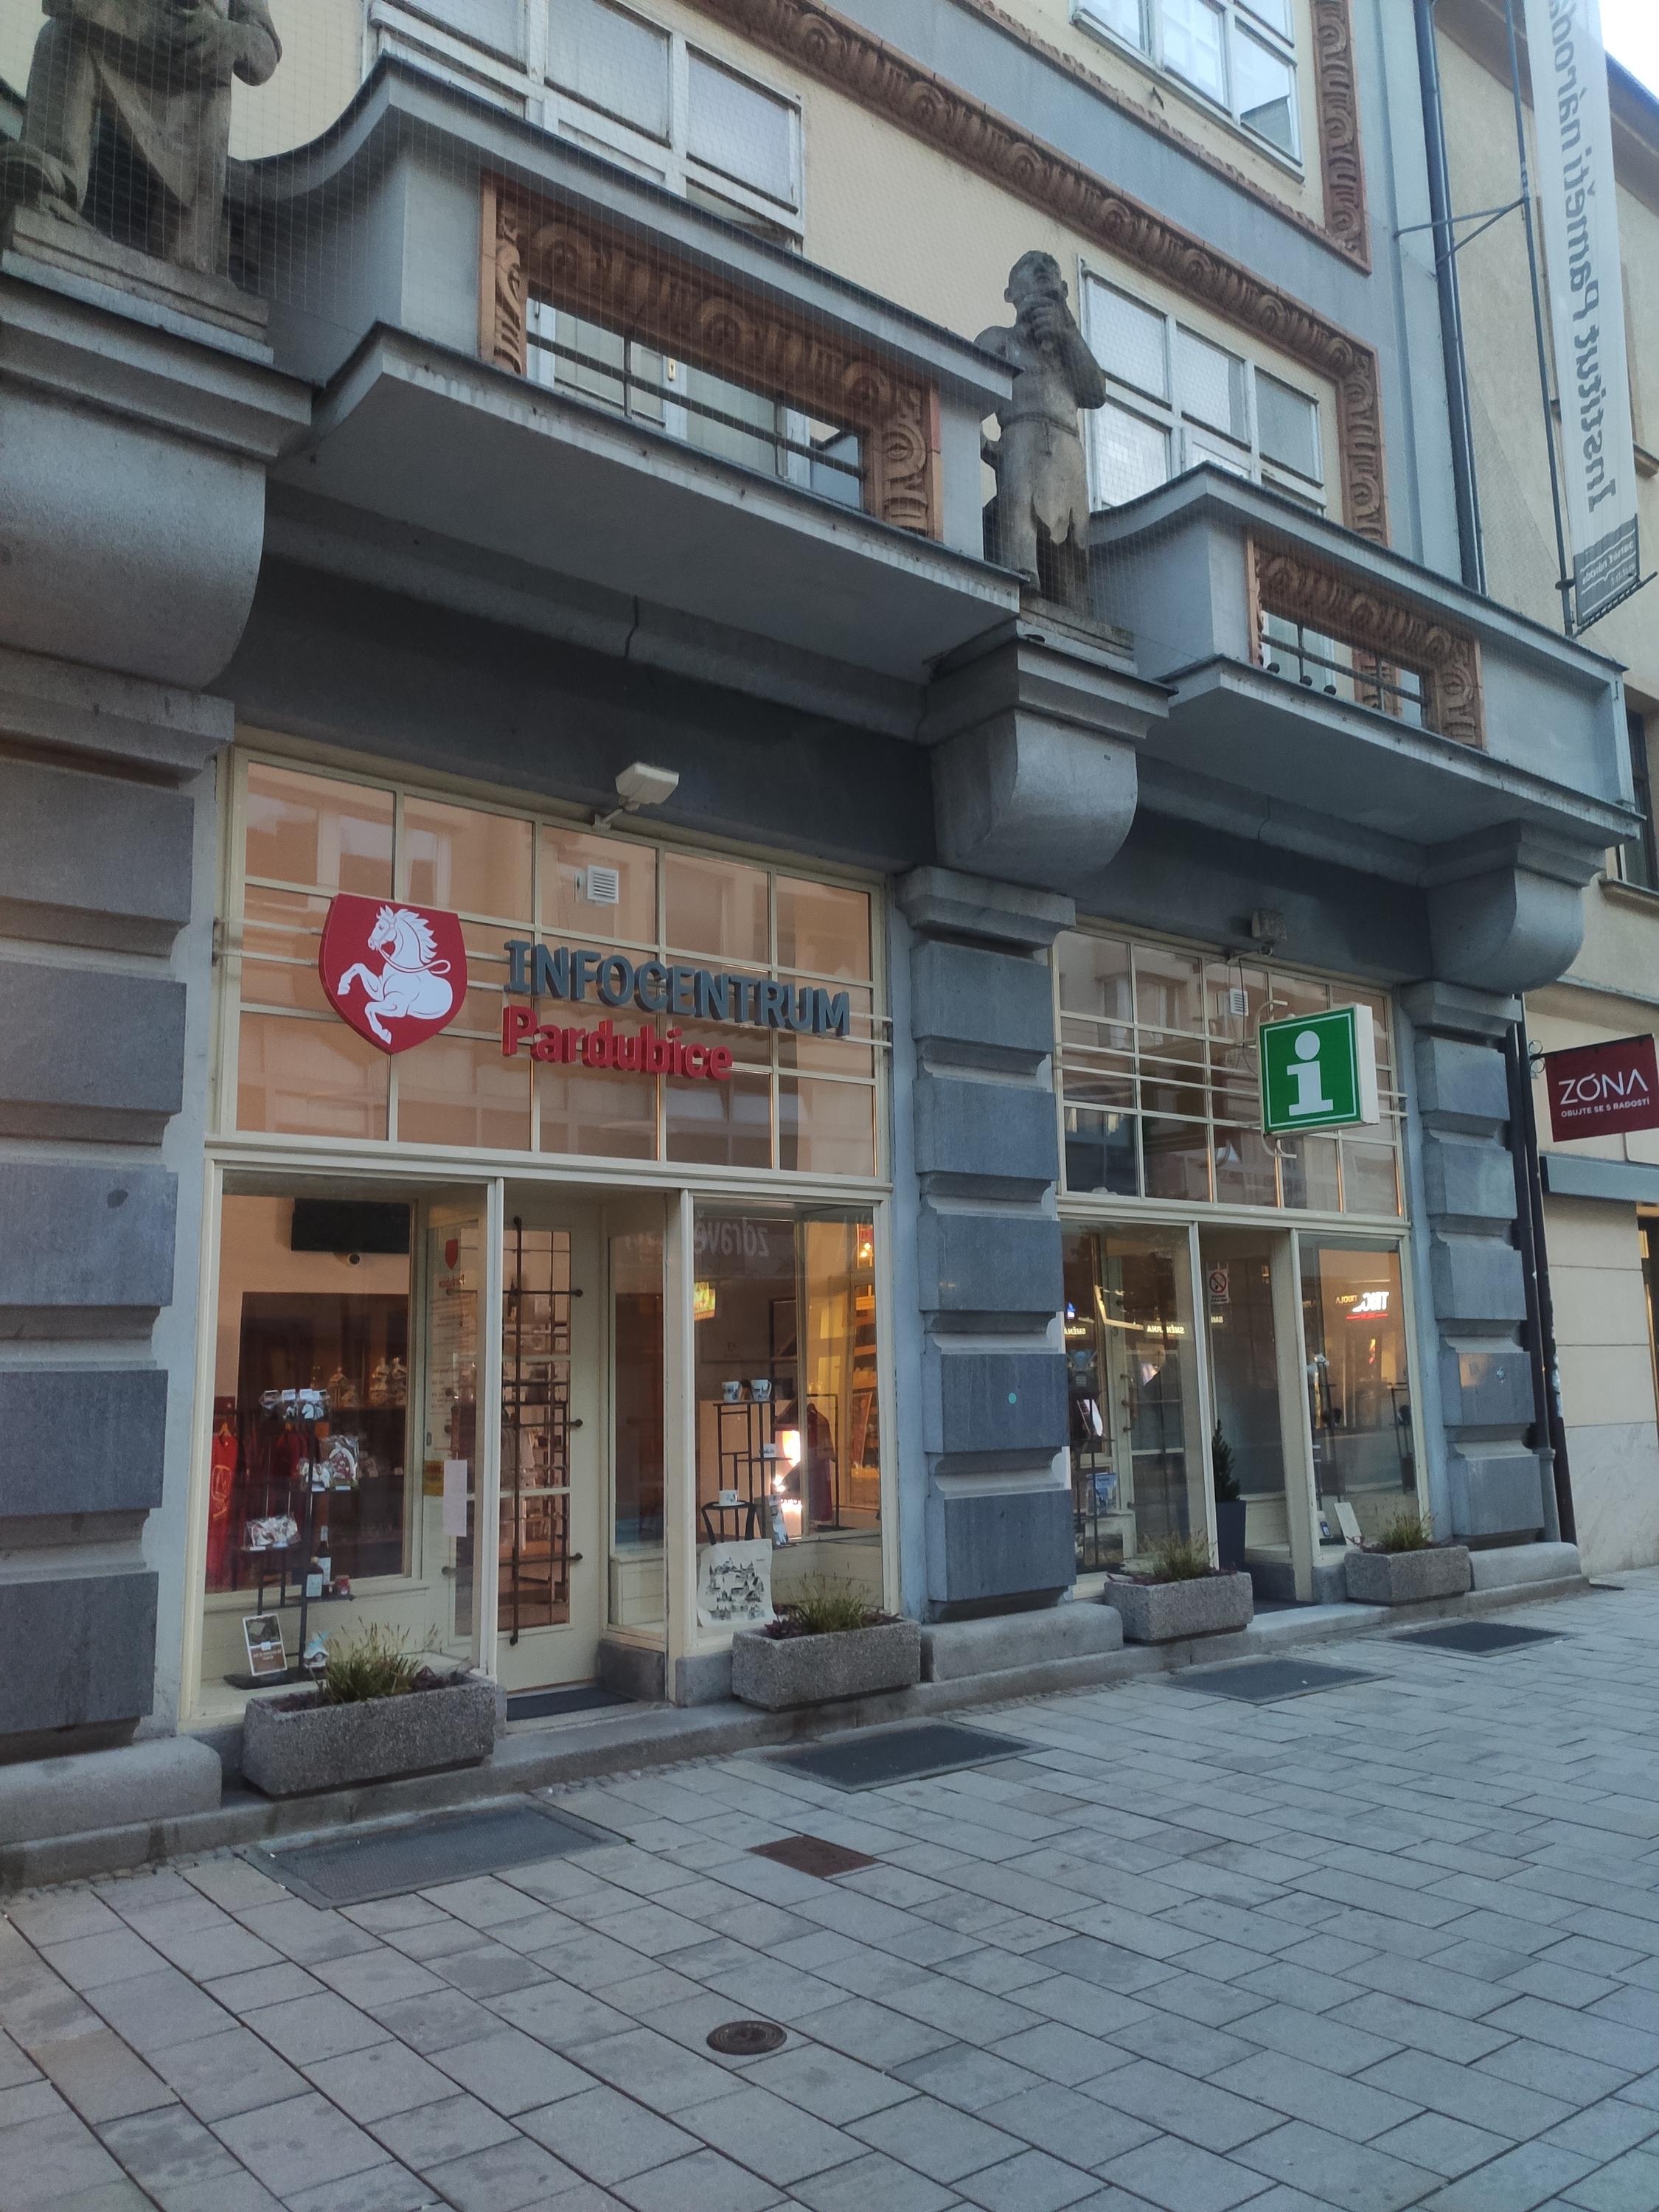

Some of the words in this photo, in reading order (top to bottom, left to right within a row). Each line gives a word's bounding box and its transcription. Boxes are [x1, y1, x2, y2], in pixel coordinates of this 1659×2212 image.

[504, 939, 849, 1037] INFOCENTRUM
[502, 1005, 733, 1081] Pardubice
[1561, 1107, 1592, 1118] OBUJTE
[1593, 1105, 1604, 1113] SE
[1606, 1103, 1611, 1111] S
[1613, 1096, 1650, 1110] RADOSTÍ
